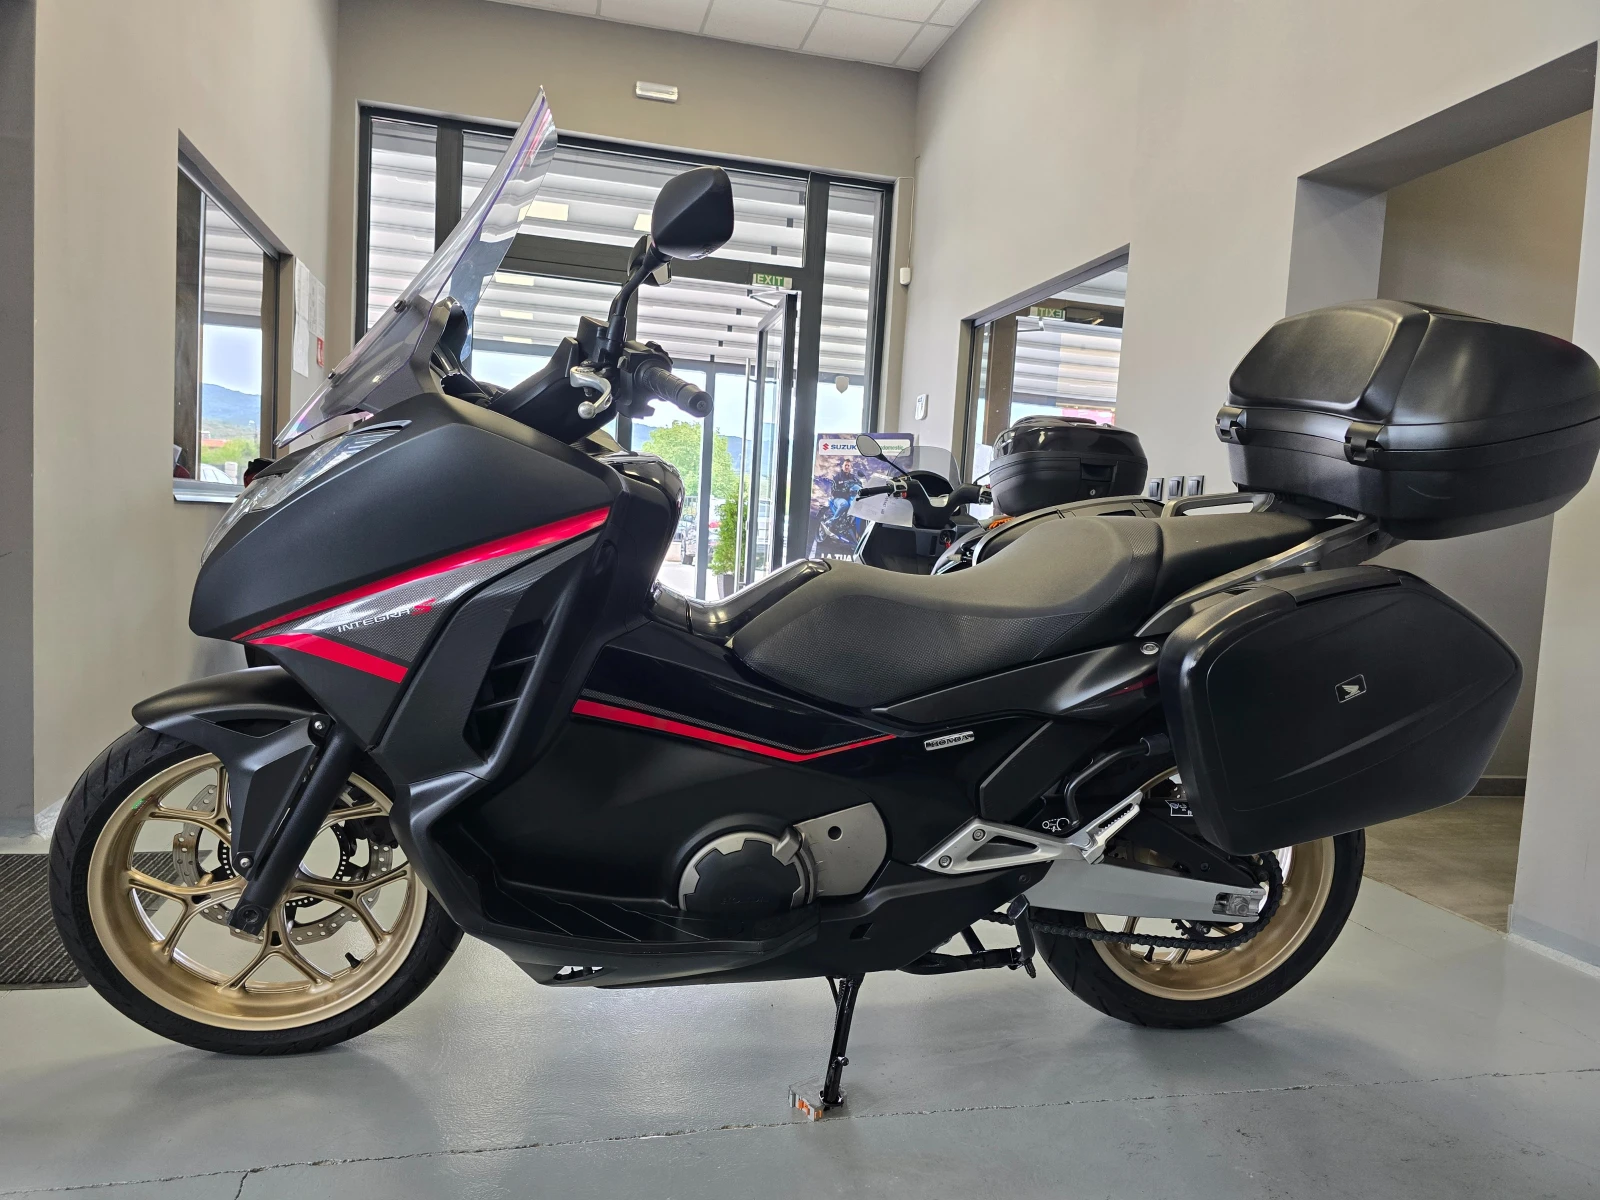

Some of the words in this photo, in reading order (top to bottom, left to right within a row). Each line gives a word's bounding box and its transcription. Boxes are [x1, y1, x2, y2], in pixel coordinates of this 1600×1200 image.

[757, 274, 783, 286] EXIT
[338, 608, 410, 632] INTEGRA
[411, 597, 436, 616] S
[931, 735, 969, 748] HONDA
